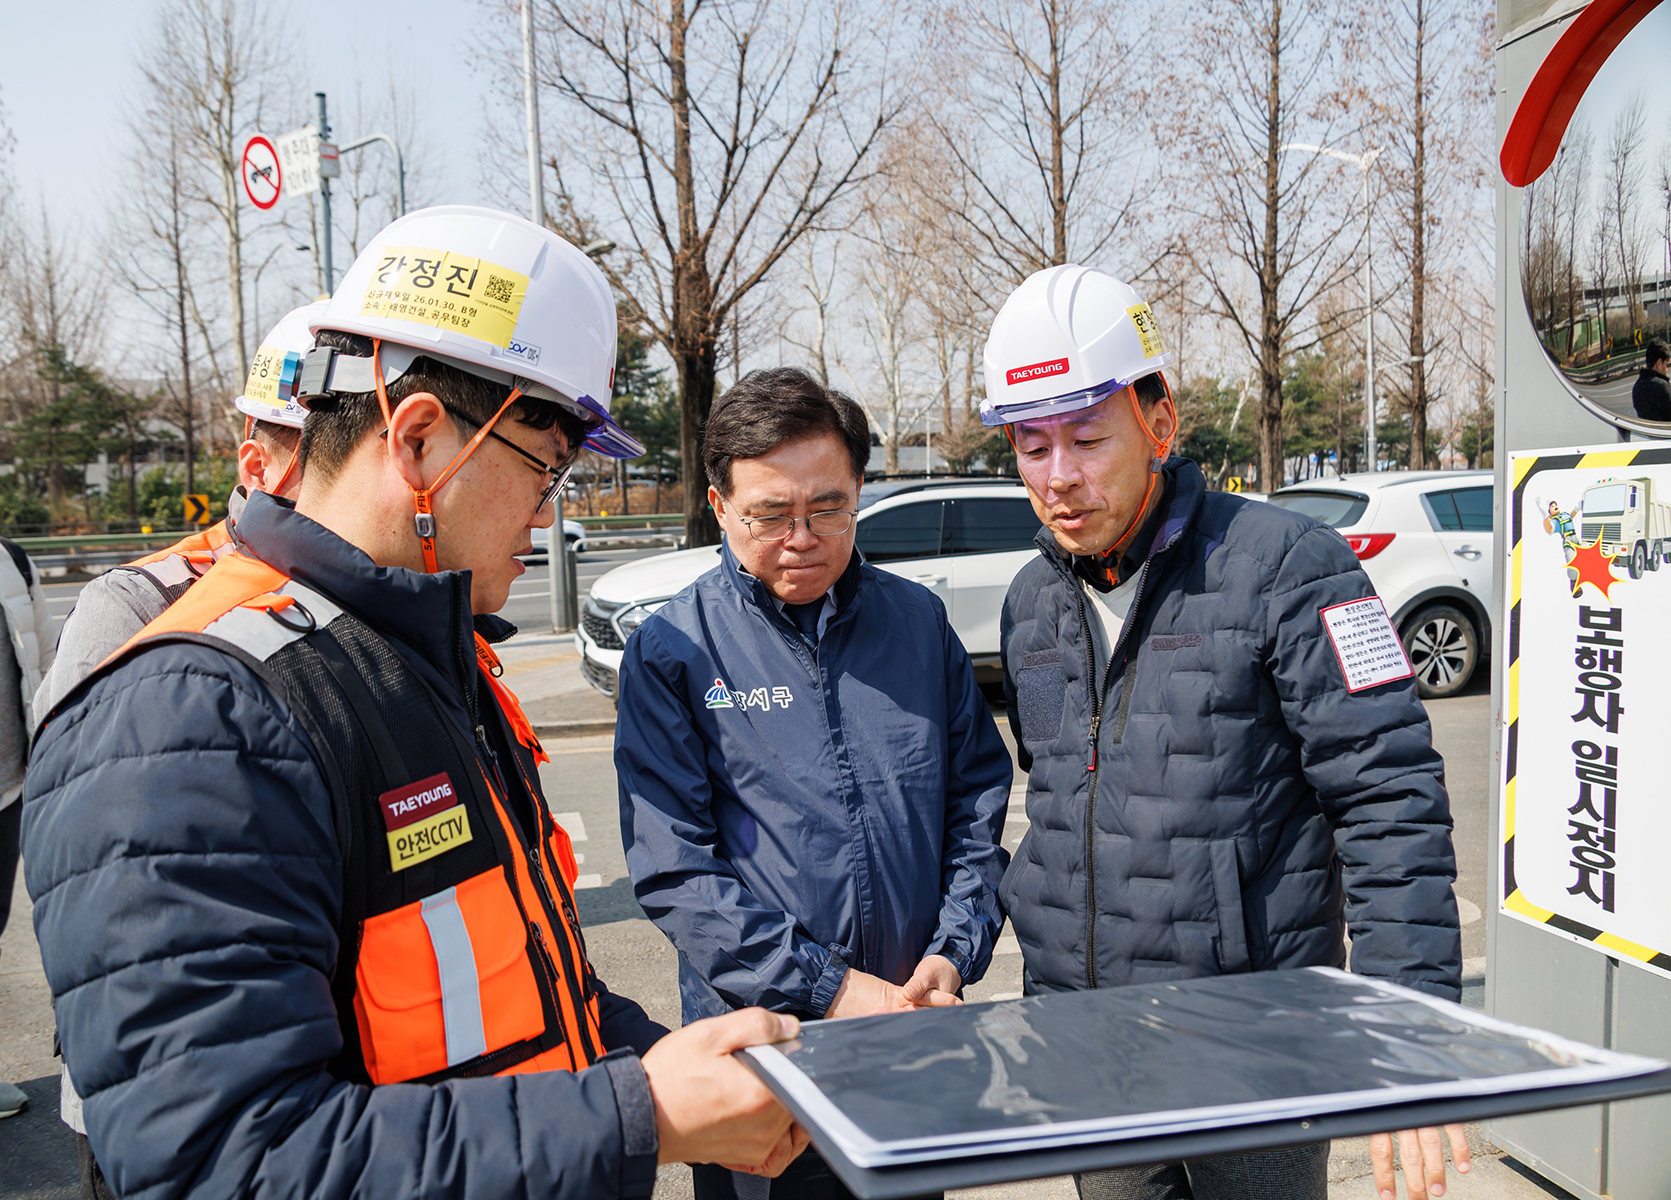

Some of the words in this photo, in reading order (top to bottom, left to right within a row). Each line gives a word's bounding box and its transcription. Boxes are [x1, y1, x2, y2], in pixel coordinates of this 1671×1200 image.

[413, 295, 457, 312] 26.01.30.
[460, 306, 478, 318] B형
[1010, 362, 1064, 381] TAEYOUNG
[1570, 604, 1625, 735] 보행자
[387, 783, 453, 817] TAEYOUNG
[396, 815, 463, 861] 안전CCTV
[1565, 738, 1619, 914] 일시정지
